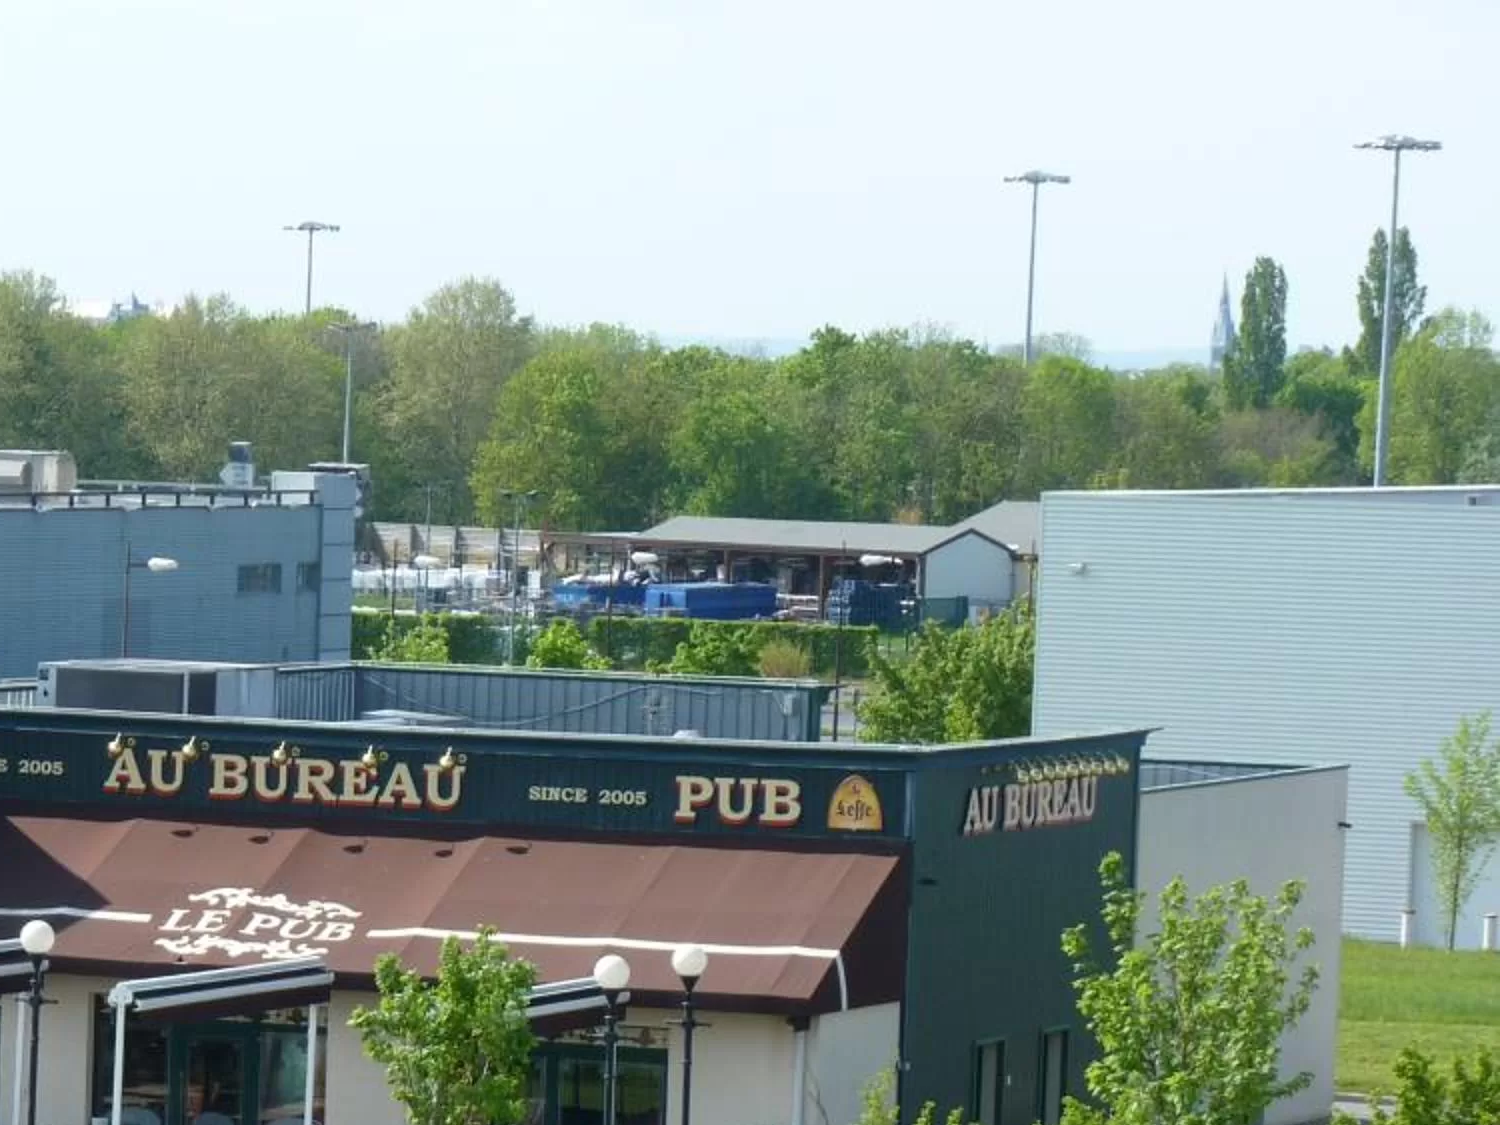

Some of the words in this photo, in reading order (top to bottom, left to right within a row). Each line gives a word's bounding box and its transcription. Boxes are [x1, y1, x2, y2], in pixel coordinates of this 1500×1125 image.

[18, 757, 64, 776] 2005
[103, 747, 186, 795] AU
[209, 754, 466, 808] BUREAU
[528, 785, 587, 804] SINCE
[599, 789, 647, 807] 2005
[674, 775, 802, 826] PUB
[963, 787, 997, 835] AU
[1003, 776, 1097, 829] BUREAU
[159, 908, 232, 934] LE
[238, 911, 354, 942] PUB
